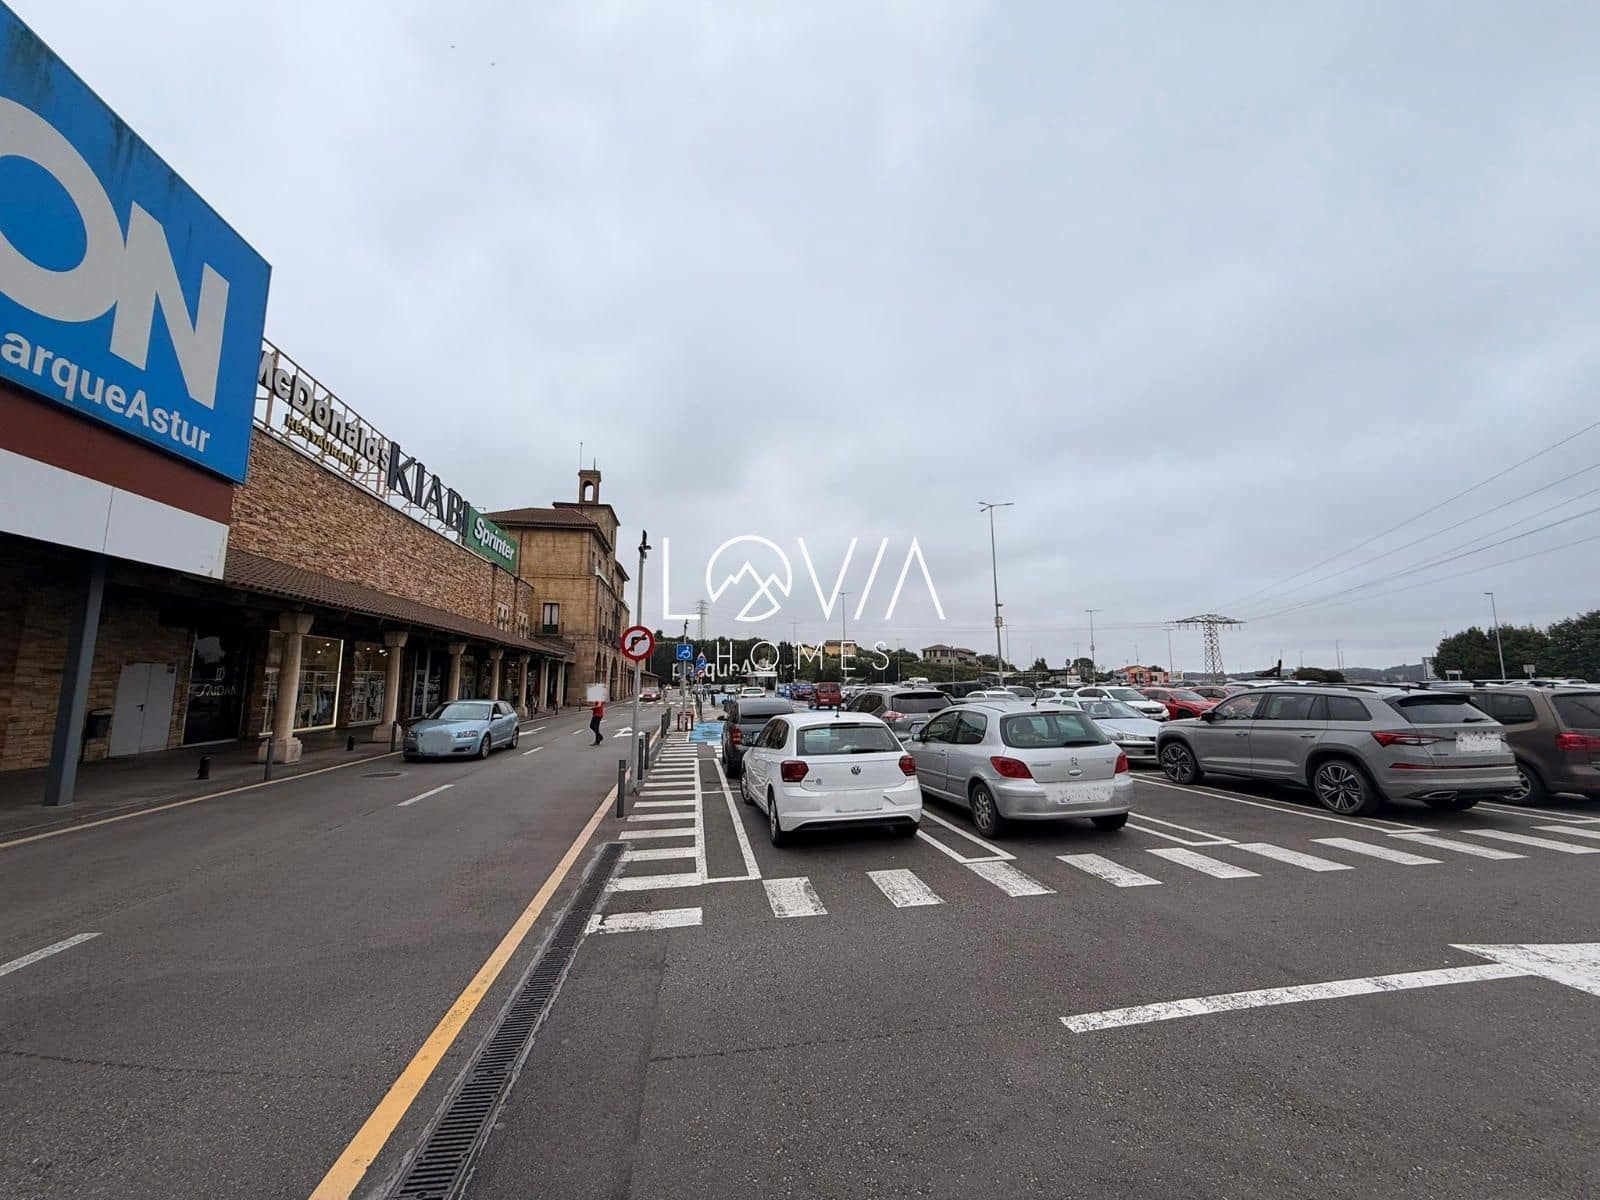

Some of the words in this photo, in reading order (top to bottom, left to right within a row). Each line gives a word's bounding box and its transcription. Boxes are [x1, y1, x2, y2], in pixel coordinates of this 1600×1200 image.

[1, 332, 211, 453] arqueAstur
[388, 441, 470, 537] KIABI
[474, 518, 515, 561] Sprinter
